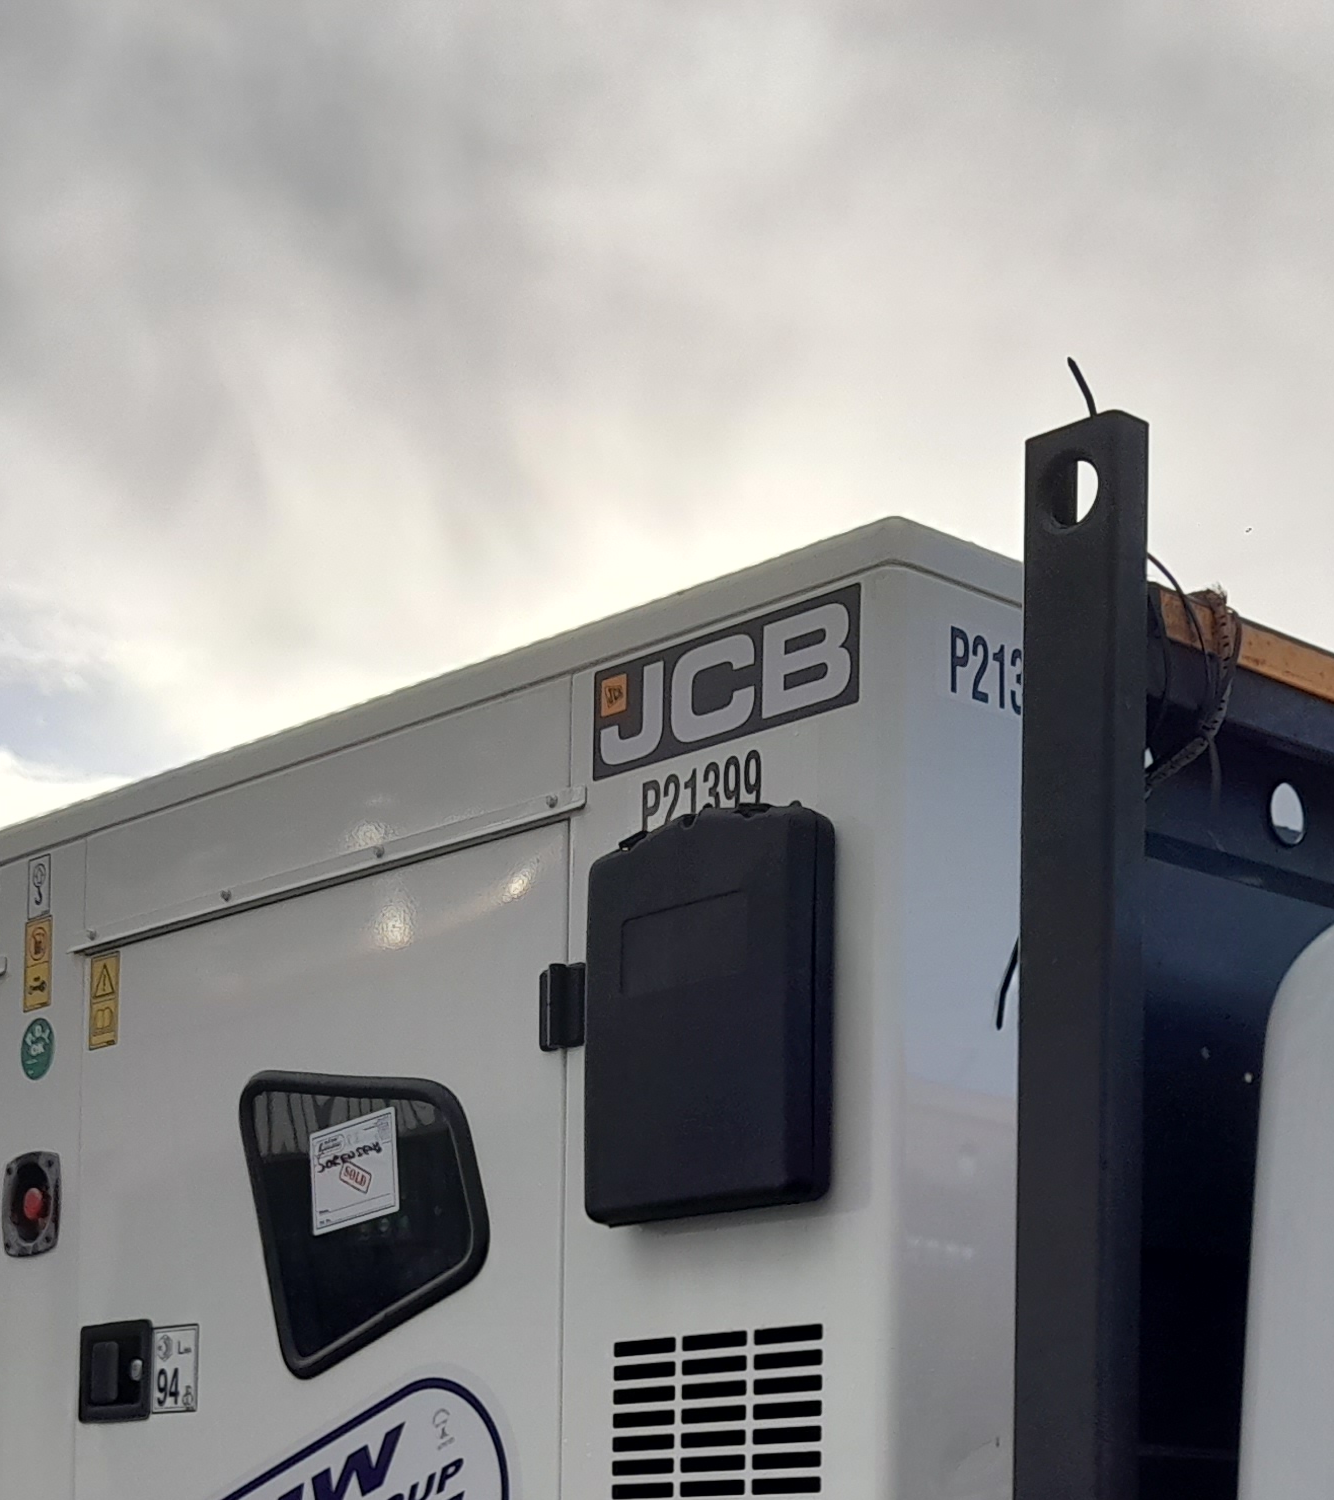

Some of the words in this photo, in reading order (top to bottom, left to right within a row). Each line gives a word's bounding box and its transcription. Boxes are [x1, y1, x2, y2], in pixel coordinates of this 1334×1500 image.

[600, 602, 852, 766] JCB
[642, 749, 762, 831] P21399
[343, 1165, 367, 1187] SOLD
[157, 1367, 180, 1406] 94
